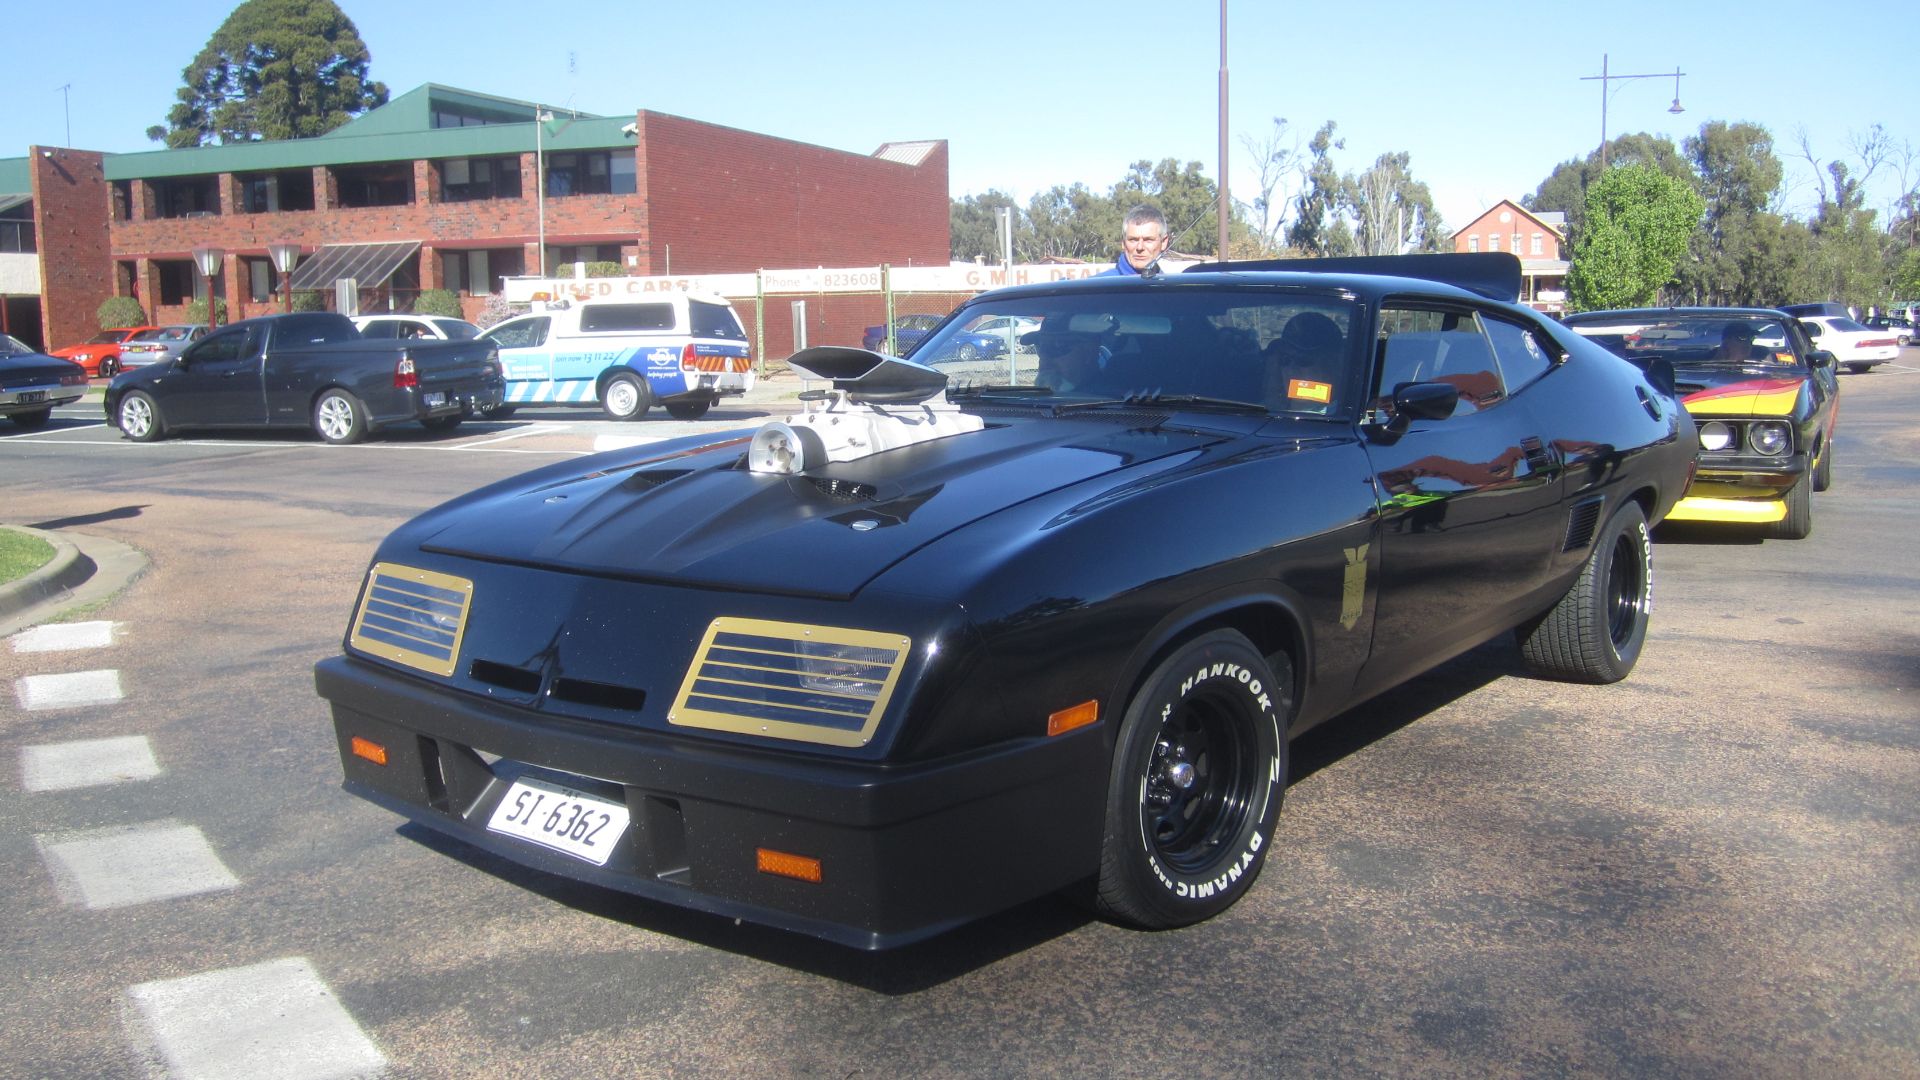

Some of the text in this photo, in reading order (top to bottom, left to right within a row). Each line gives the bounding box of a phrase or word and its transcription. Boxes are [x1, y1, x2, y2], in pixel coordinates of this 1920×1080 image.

[765, 276, 801, 288] Phone
[823, 273, 878, 287] 823608
[1638, 522, 1652, 615] CYCLONE
[1181, 663, 1272, 713] HANKOOK
[1176, 831, 1263, 899] DYNAMIC
